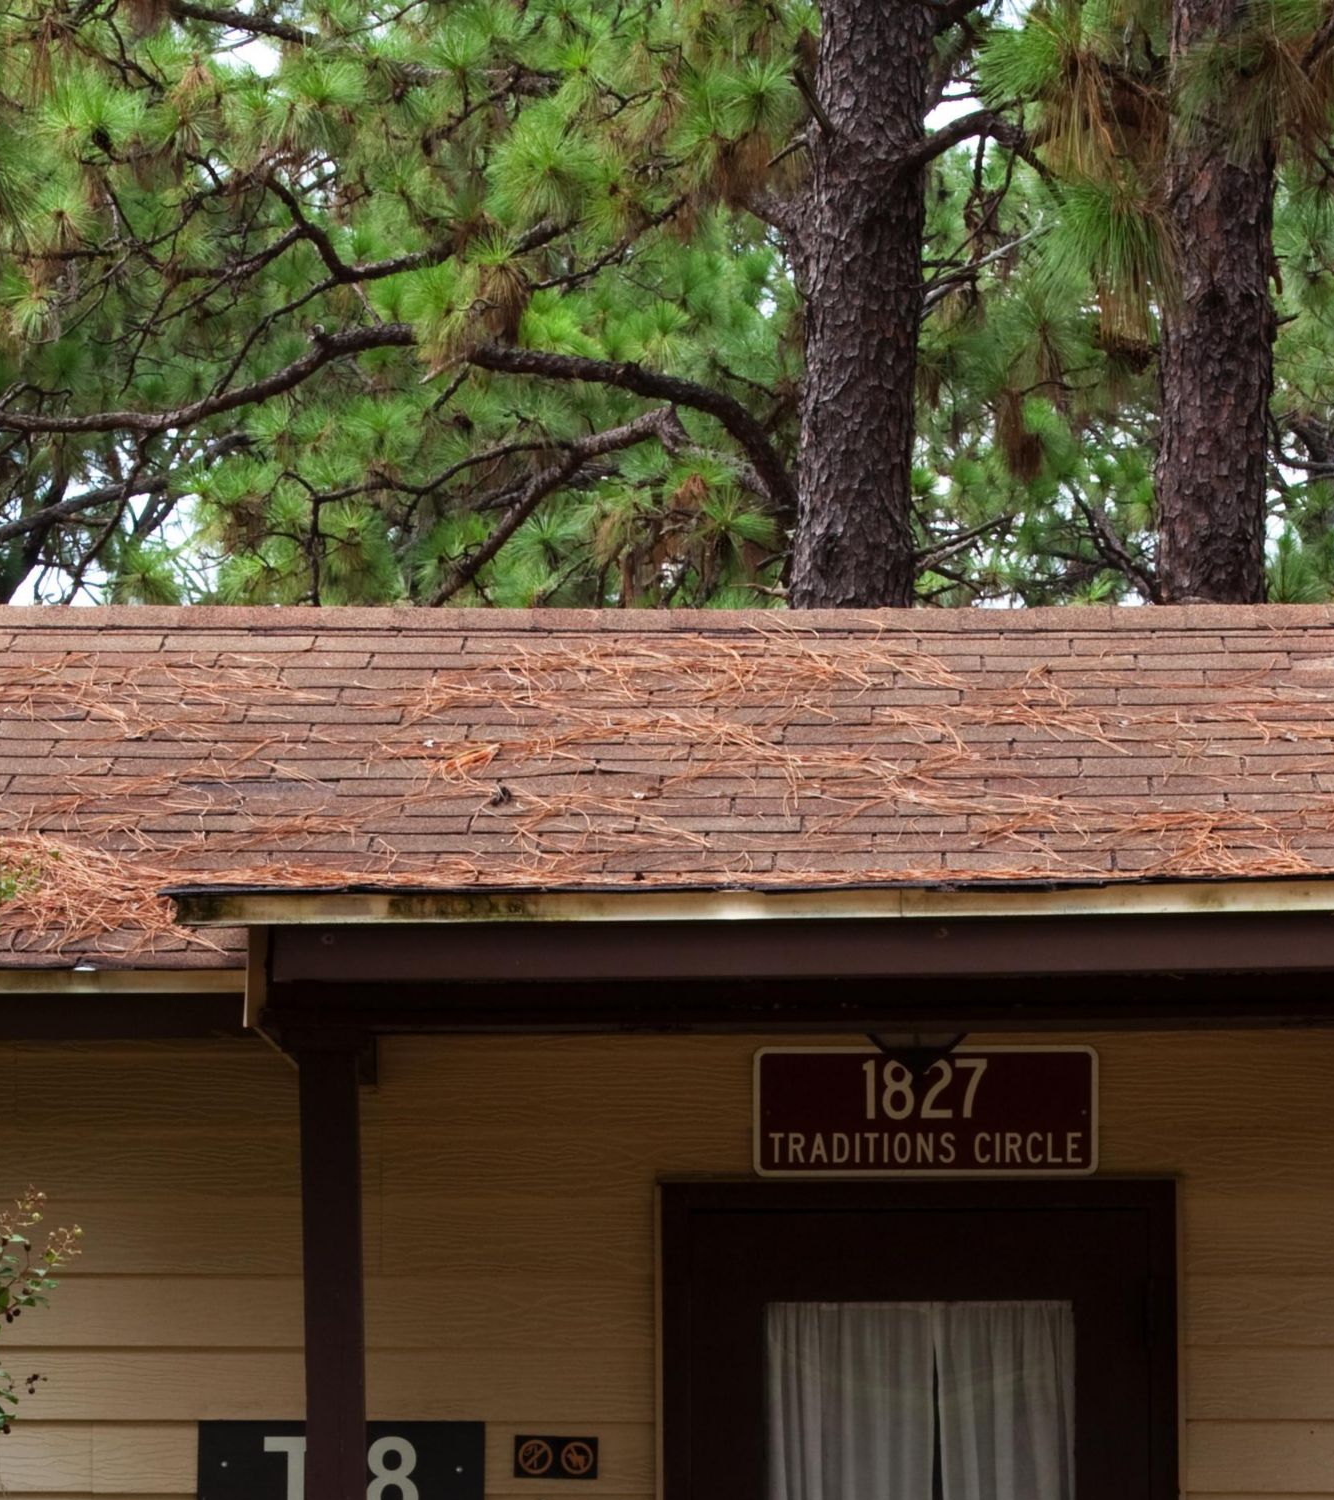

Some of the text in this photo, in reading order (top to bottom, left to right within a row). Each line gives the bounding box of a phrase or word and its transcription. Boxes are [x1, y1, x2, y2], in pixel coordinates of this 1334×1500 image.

[862, 1058, 987, 1120] 1827
[769, 1132, 1082, 1164] TRADITIONS CIRCLE
